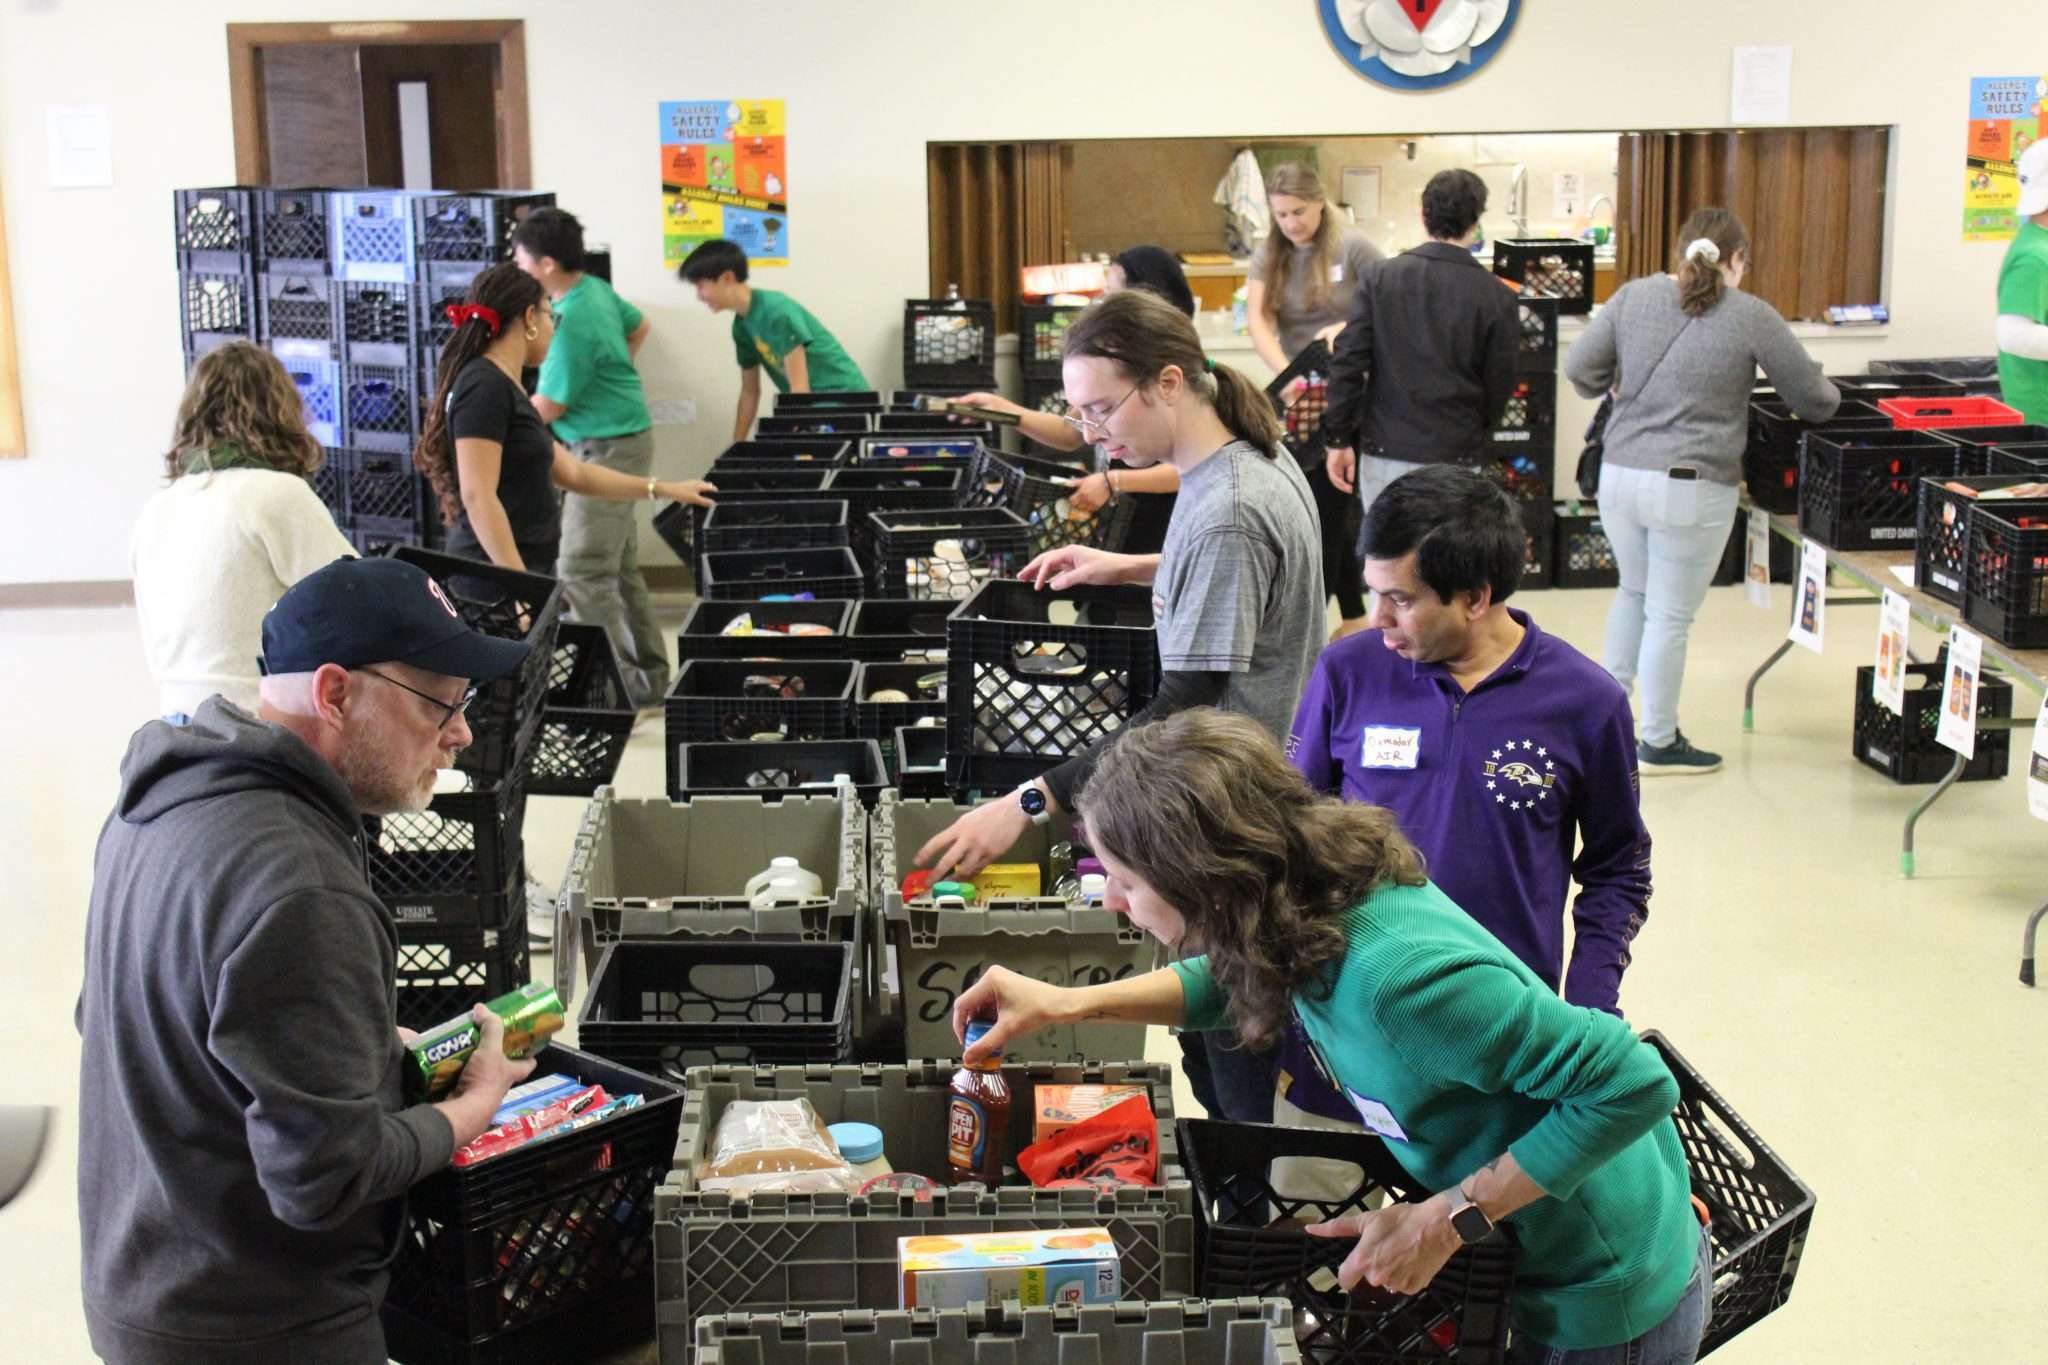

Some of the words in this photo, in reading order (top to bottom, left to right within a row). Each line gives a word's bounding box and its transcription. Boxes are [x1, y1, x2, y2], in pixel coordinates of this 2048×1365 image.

[1982, 91, 2029, 102] SAFETY
[1986, 103, 2023, 114] RULES
[672, 116, 720, 127] SAFETY
[678, 128, 716, 139] RULES
[1871, 527, 1897, 539] UNITED
[1376, 750, 1403, 761] AIR
[952, 1110, 973, 1128] OPEN
[952, 1122, 973, 1141] PIT
